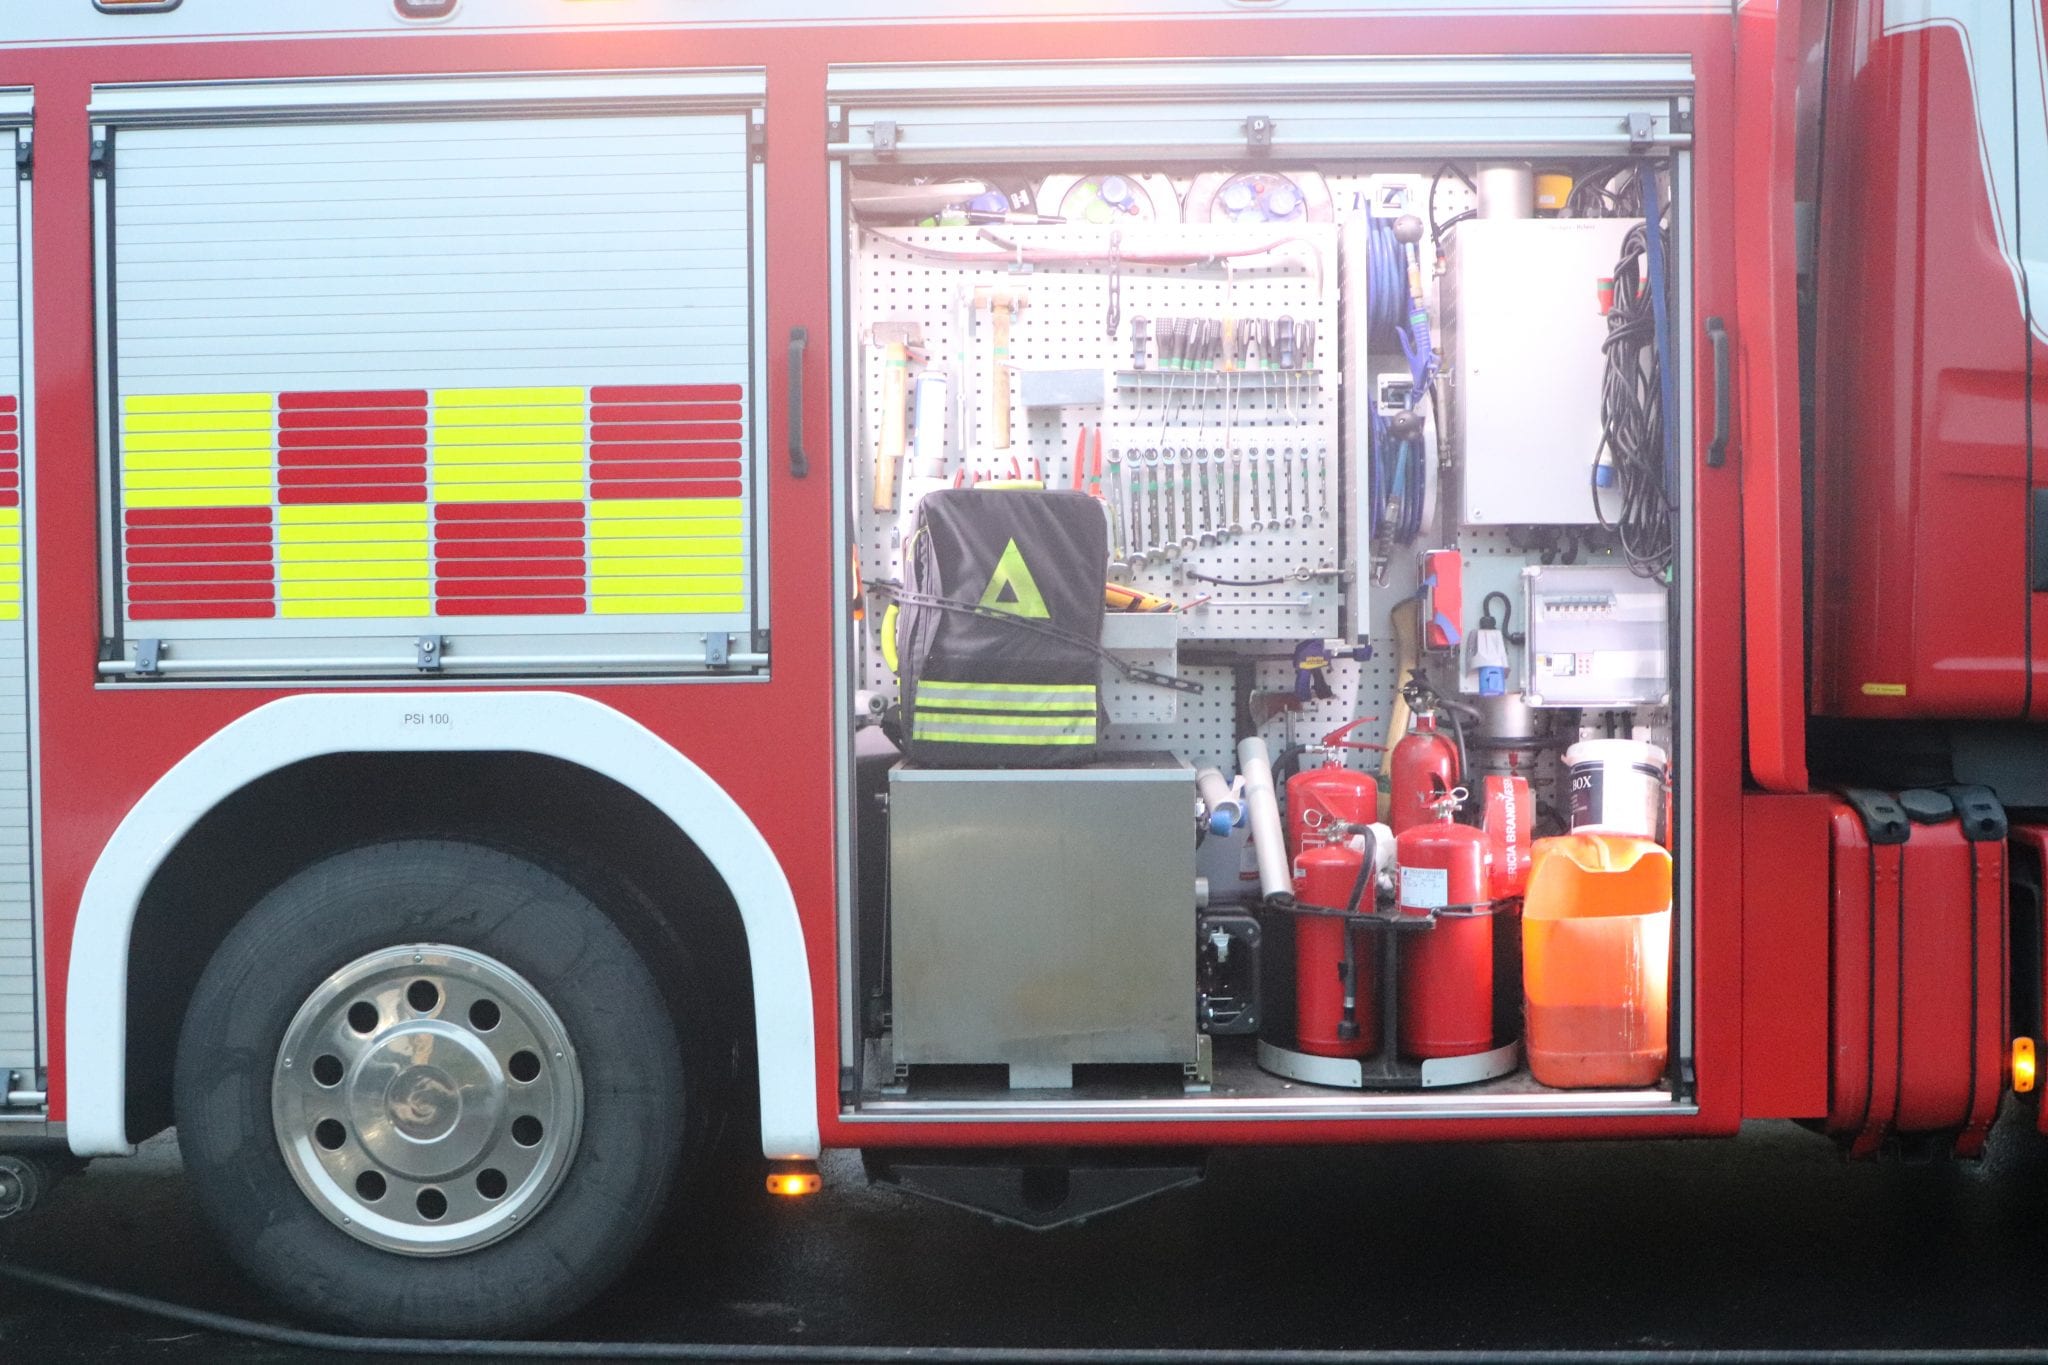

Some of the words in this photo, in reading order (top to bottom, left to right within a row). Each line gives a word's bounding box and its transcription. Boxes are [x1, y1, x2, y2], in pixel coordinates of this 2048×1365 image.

[404, 713, 424, 725] PSI
[429, 713, 449, 725] 100
[1572, 775, 1592, 792] BOX
